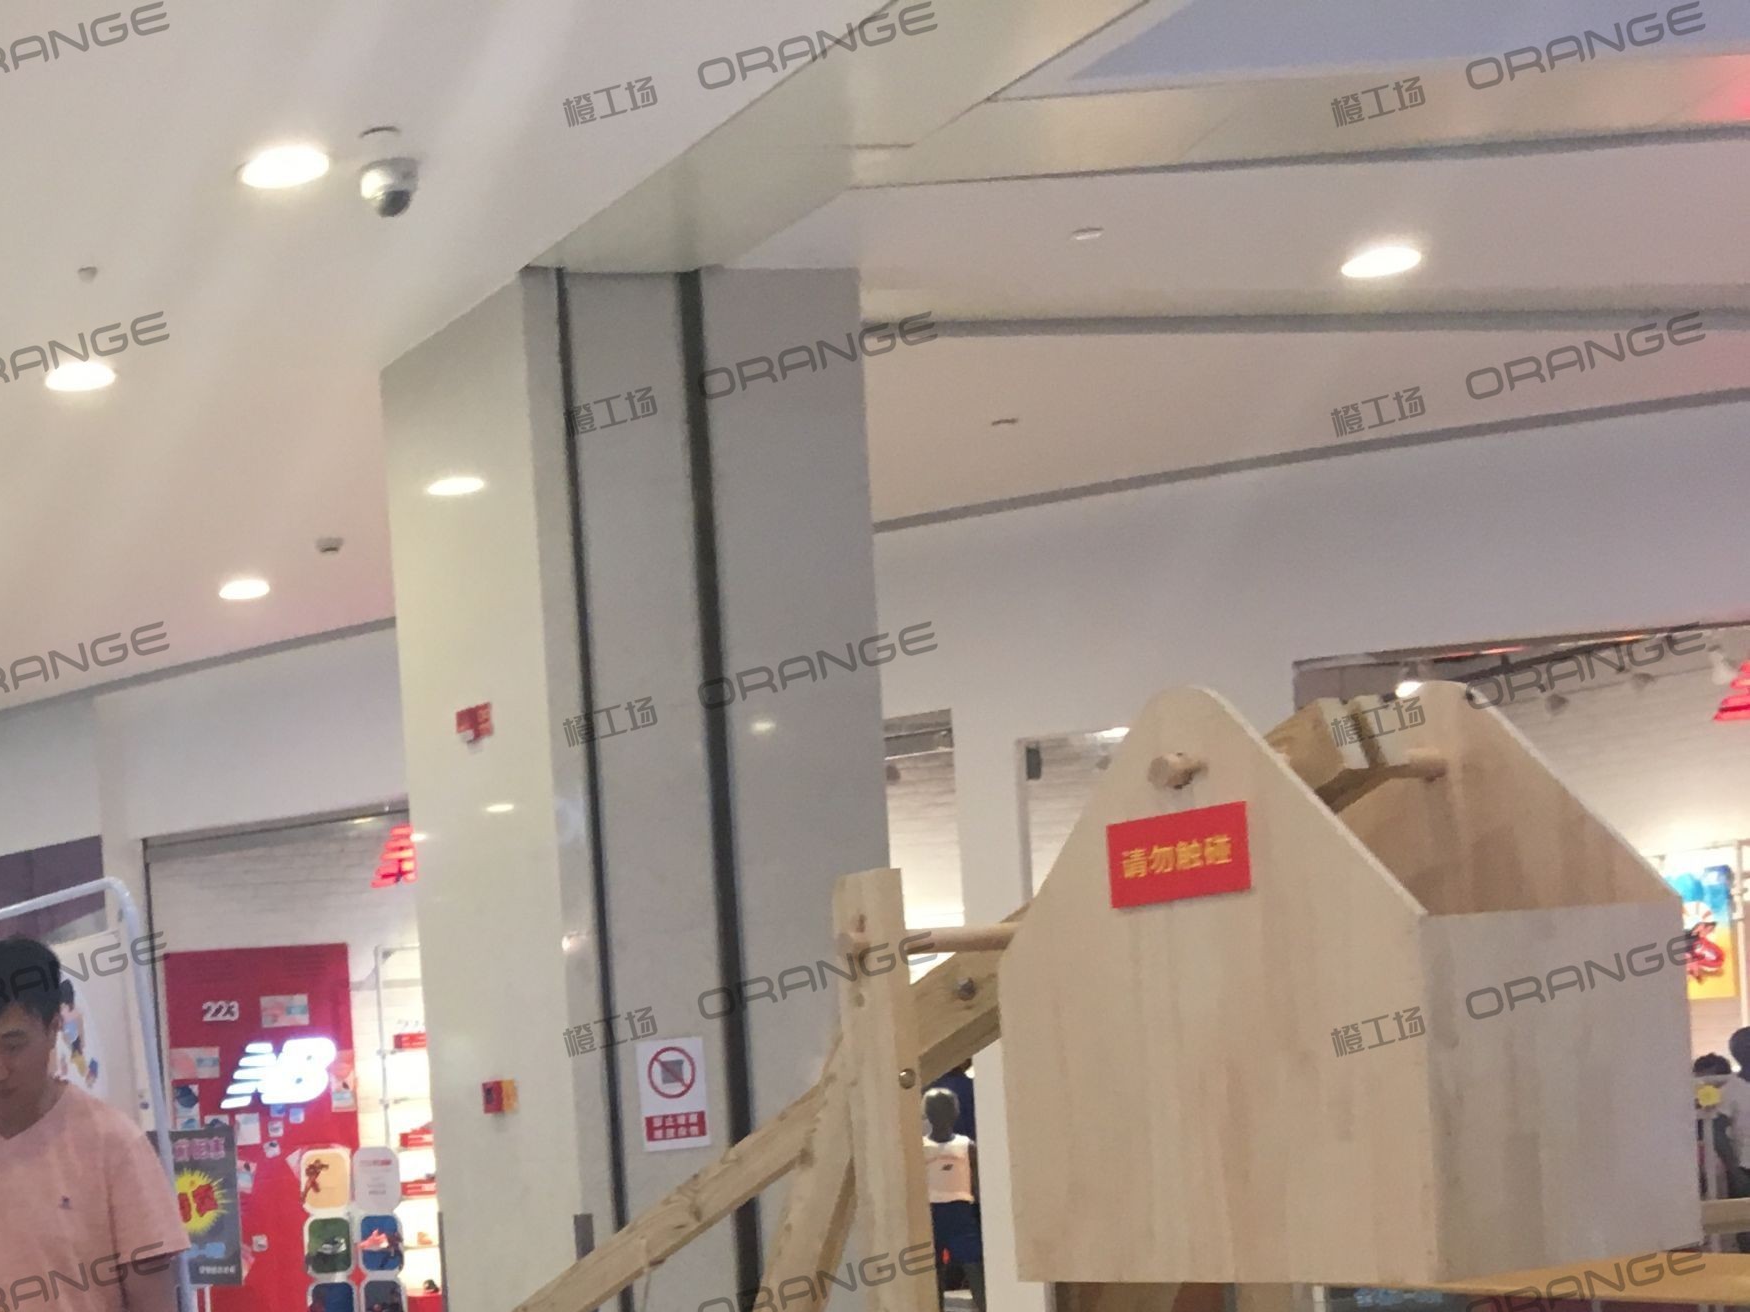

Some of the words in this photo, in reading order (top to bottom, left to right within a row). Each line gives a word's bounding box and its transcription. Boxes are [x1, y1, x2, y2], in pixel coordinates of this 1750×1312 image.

[1121, 834, 1233, 880] 请勿触碰
[202, 1001, 239, 1022] 223
